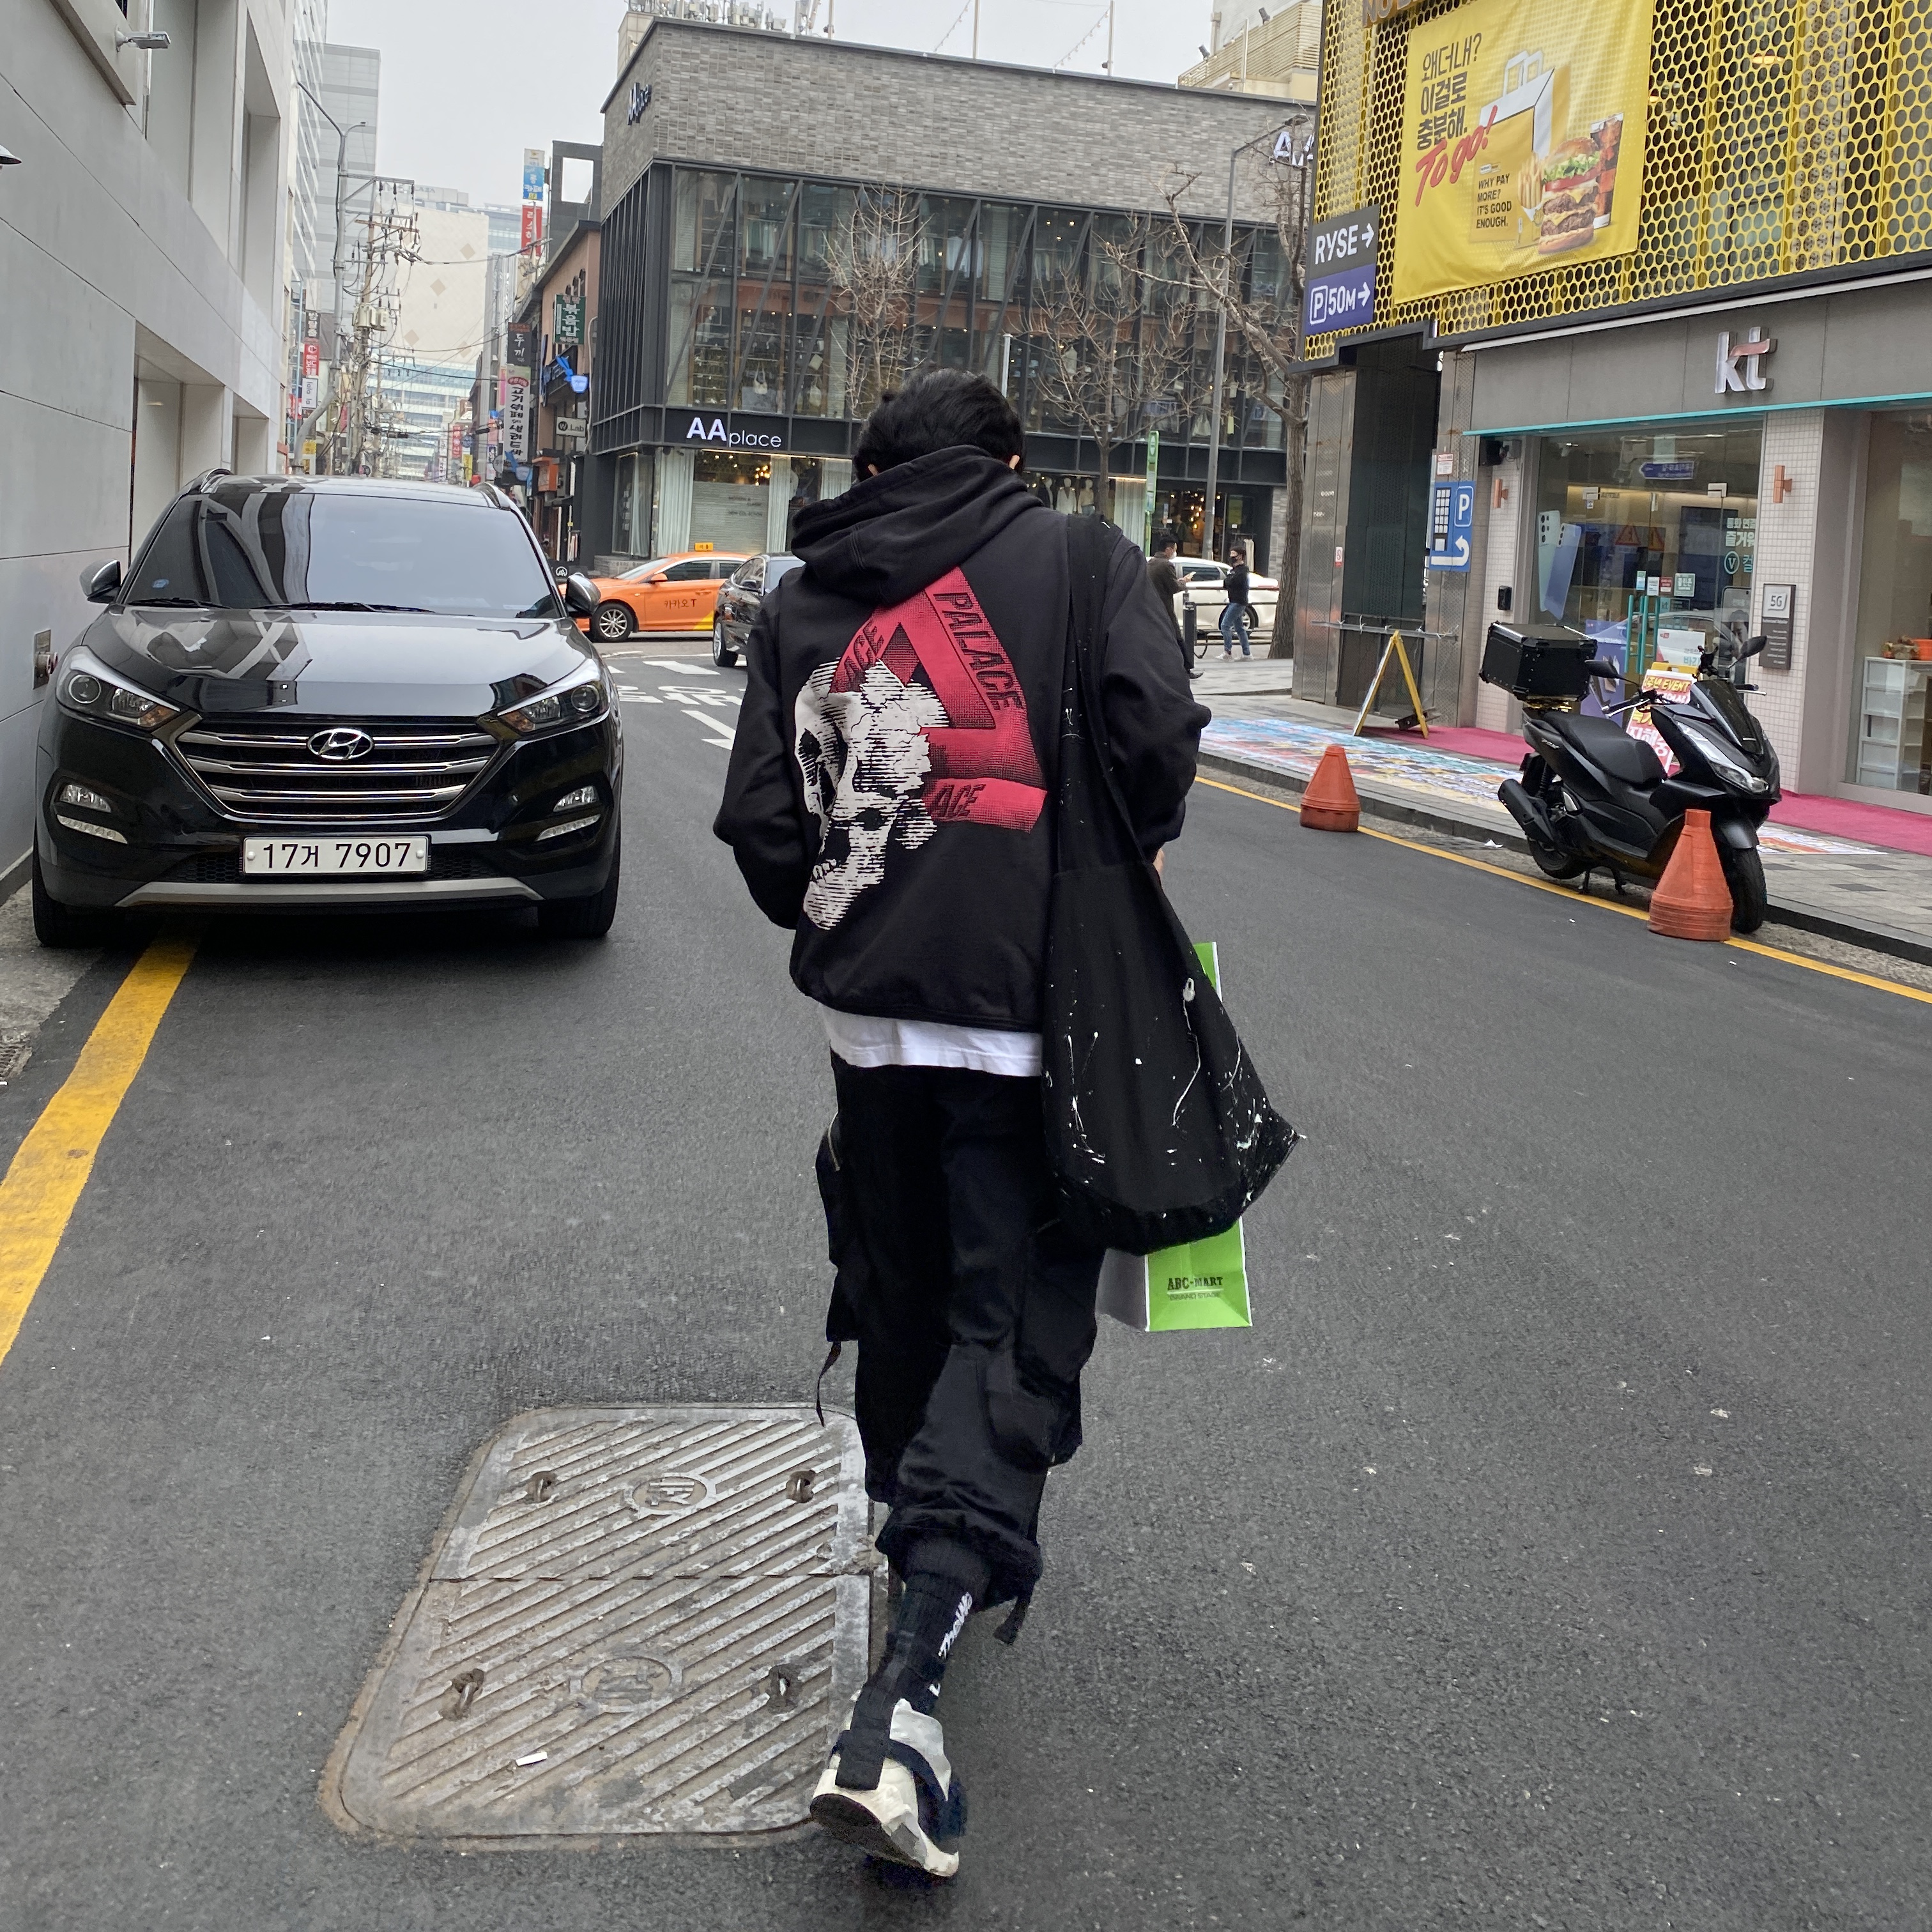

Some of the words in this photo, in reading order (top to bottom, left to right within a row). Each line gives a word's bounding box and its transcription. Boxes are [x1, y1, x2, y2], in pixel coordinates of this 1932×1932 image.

[1421, 71, 1468, 115] 이걸로
[1478, 176, 1495, 190] WHY
[1496, 173, 1510, 186] PAY
[1477, 189, 1501, 203] MORE?
[1477, 204, 1489, 216] IT'S
[1491, 201, 1512, 214] GOOD
[1476, 216, 1508, 229] ENOUGH.
[1314, 224, 1359, 264] RYSE
[1328, 286, 1356, 316] 50M
[1715, 326, 1776, 394] kt
[728, 430, 782, 447] place
[1457, 494, 1470, 521] P
[664, 599, 689, 610] 카카오
[691, 599, 697, 608] T
[1770, 595, 1782, 607] 5G
[933, 591, 1023, 711] PALACE
[1661, 678, 1691, 693] EVENT
[263, 843, 319, 869] 17거
[335, 842, 411, 868] 7907
[1167, 1276, 1223, 1291] ABC-MART
